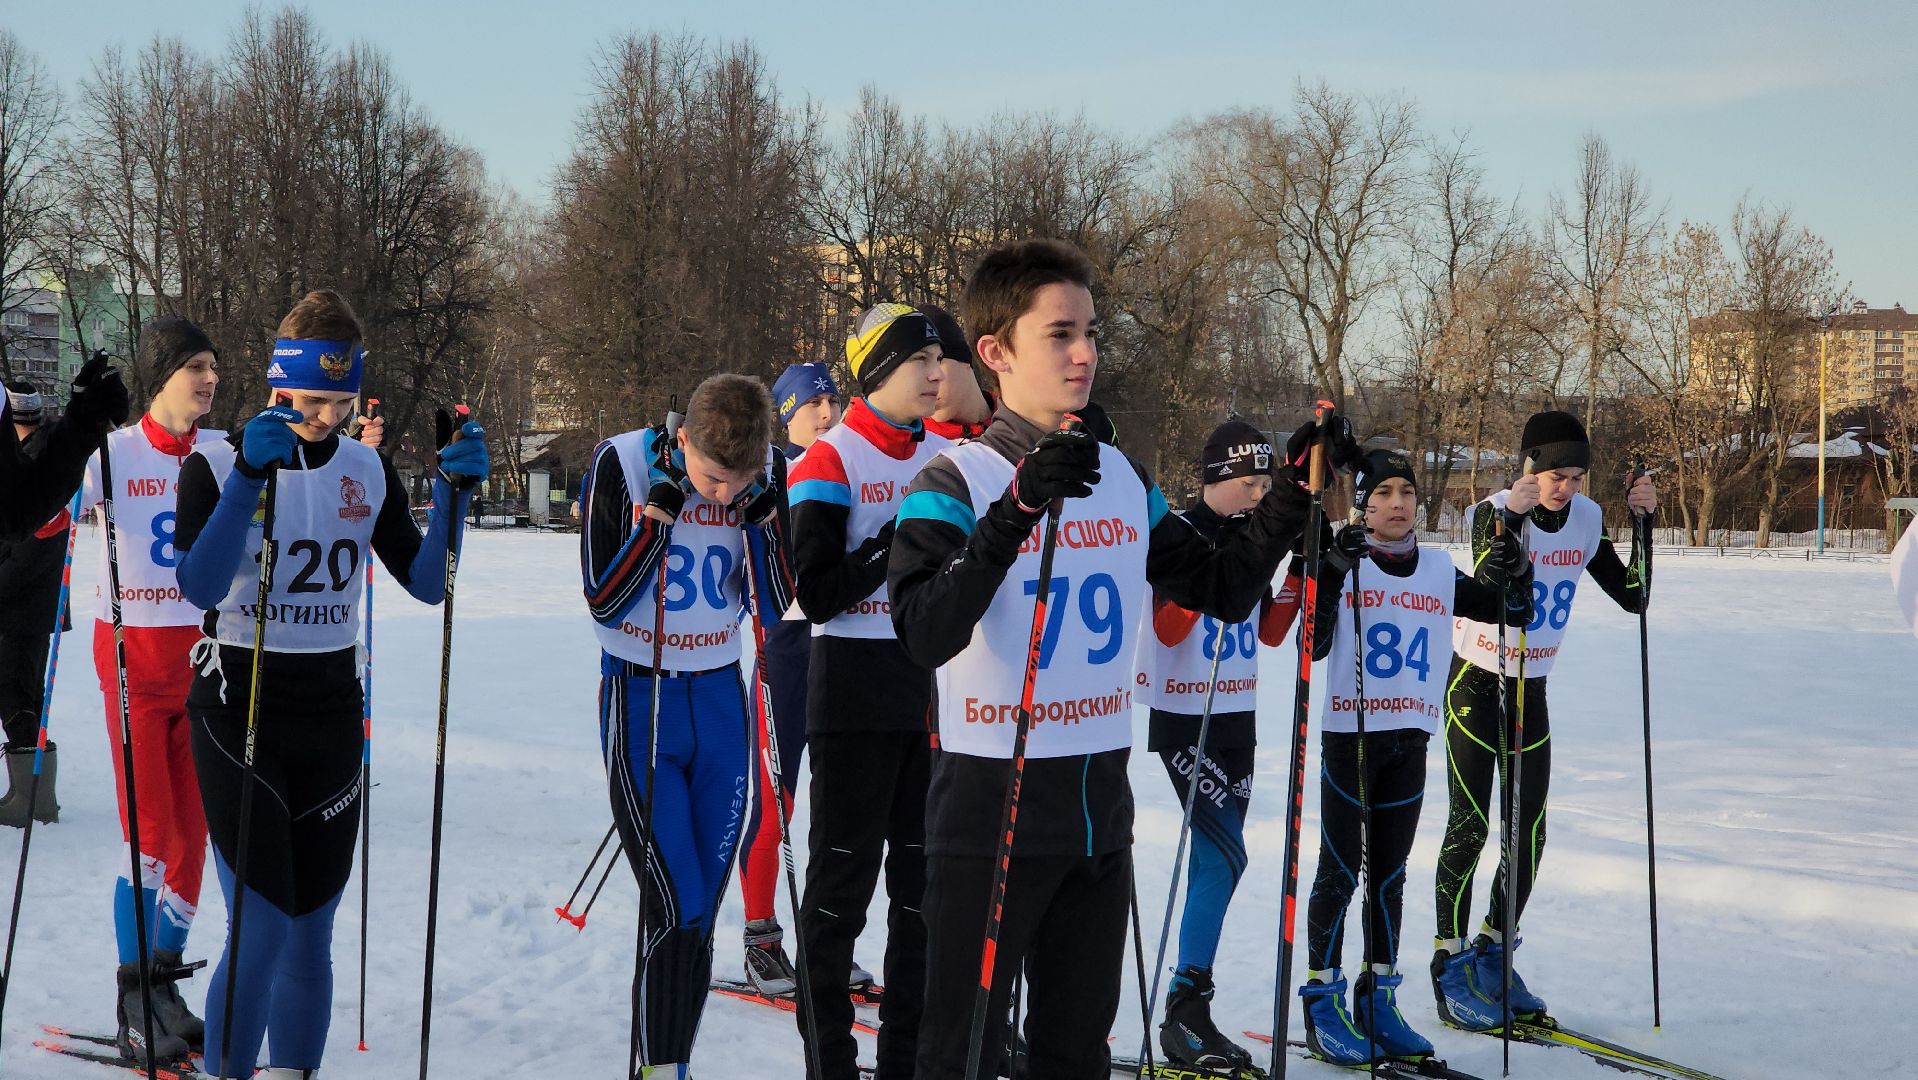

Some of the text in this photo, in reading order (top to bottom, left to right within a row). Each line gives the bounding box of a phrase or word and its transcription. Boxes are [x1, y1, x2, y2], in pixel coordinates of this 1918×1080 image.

[1228, 443, 1274, 458] LUKO
[127, 479, 167, 497] МБУ
[861, 480, 895, 504] МБУ
[1055, 517, 1138, 550] «СШОР»
[254, 538, 359, 593] 120
[652, 544, 733, 612] 80
[1023, 572, 1124, 670] 79
[1390, 591, 1447, 617] «СШОР»
[1202, 614, 1257, 662] 86
[1365, 621, 1431, 683] 84
[1164, 673, 1257, 695] Богоодский
[1188, 745, 1228, 786] SANIA
[1445, 994, 1495, 1028] SPINE
[1315, 1025, 1365, 1063] SPINE
[1391, 1062, 1419, 1074] ATOMIC
